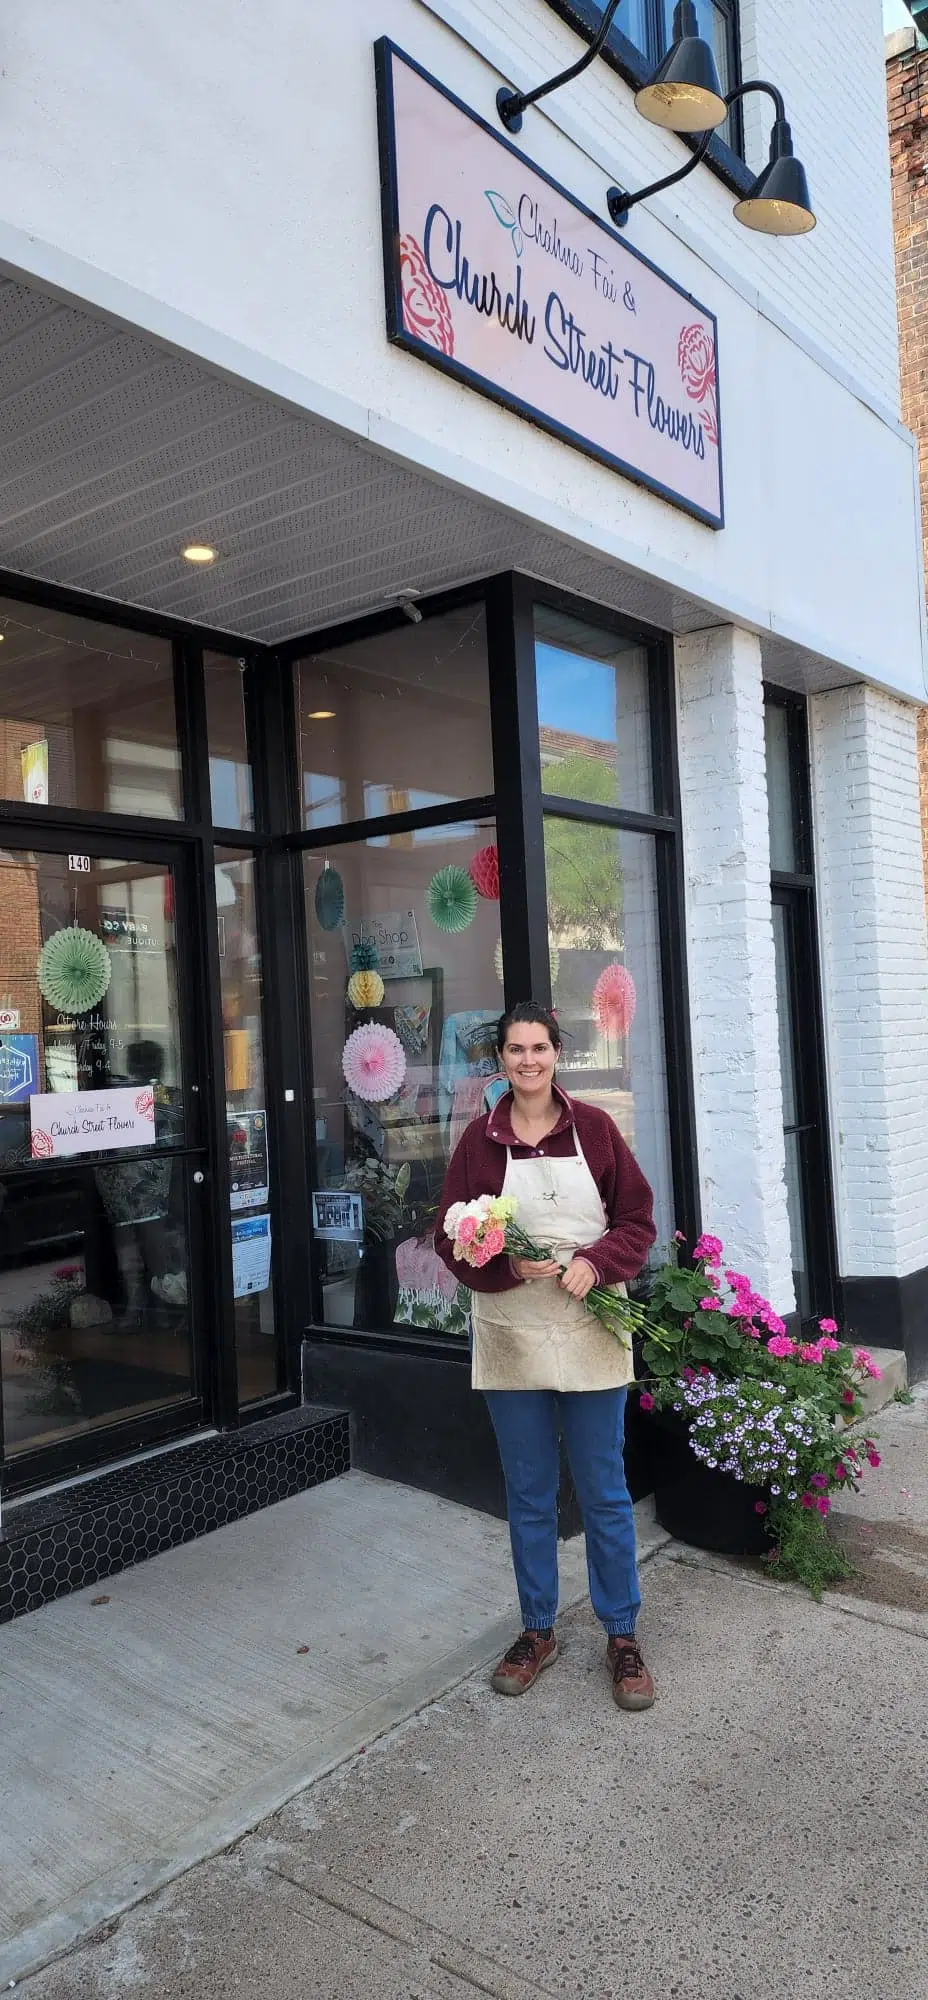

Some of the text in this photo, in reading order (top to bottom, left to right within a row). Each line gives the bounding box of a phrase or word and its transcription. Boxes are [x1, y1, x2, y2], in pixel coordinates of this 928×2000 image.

[587, 249, 617, 303] Fai
[623, 281, 637, 316] &
[424, 204, 705, 460] Church Street Flowers
[71, 855, 89, 871] 140
[379, 928, 409, 945] Shop
[89, 1013, 118, 1031] Hours
[50, 1116, 135, 1137] Church Street Flowers
